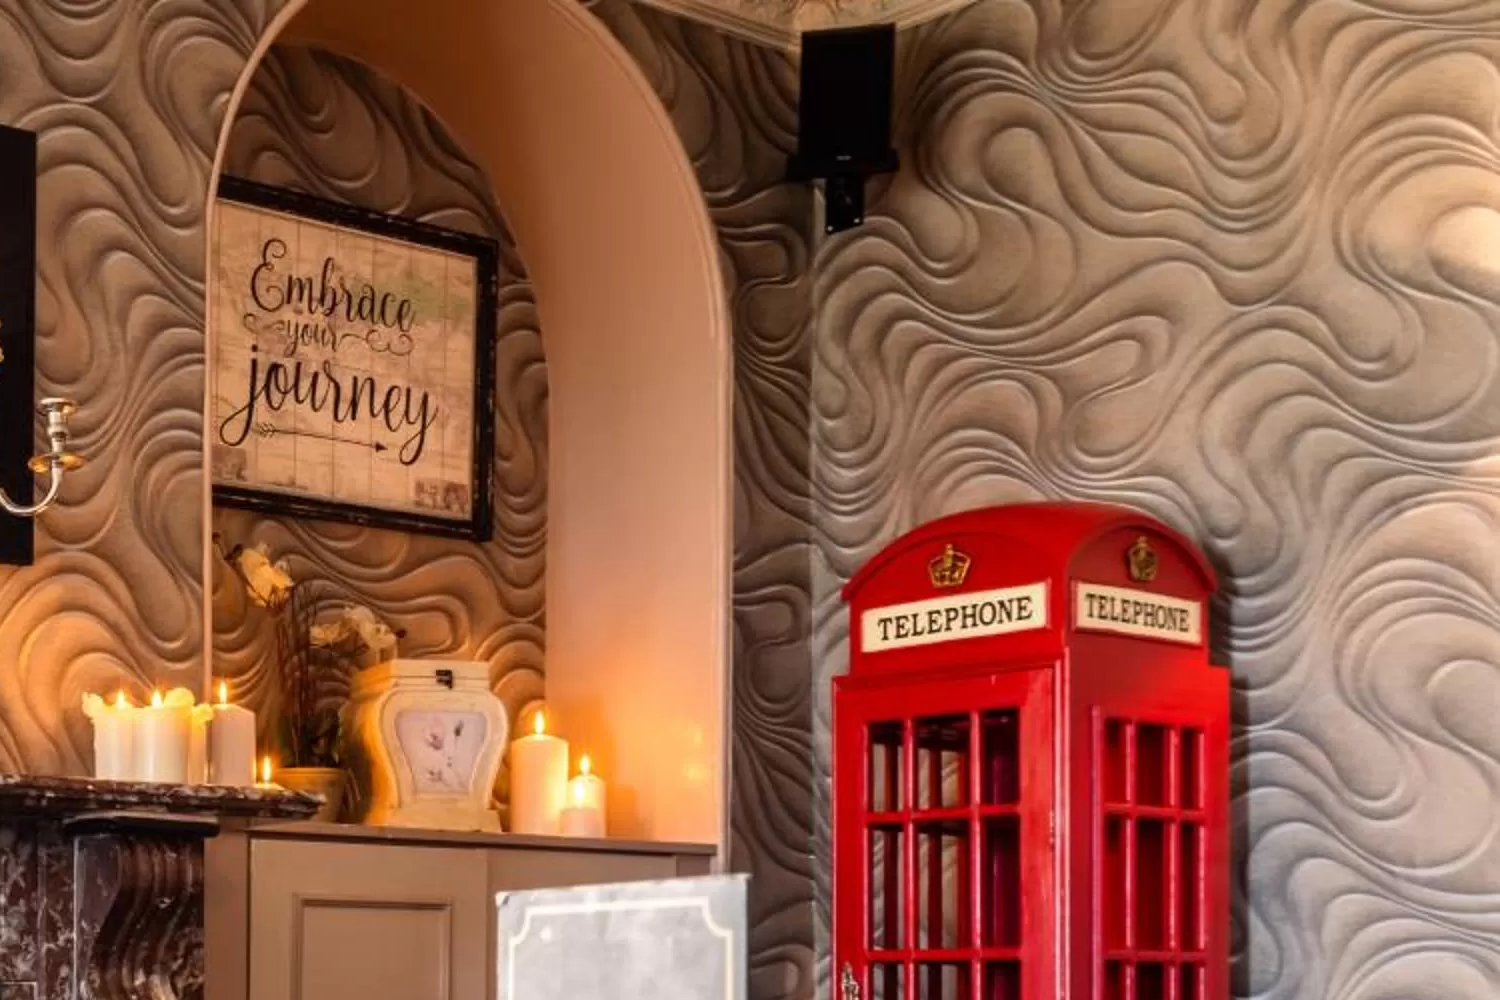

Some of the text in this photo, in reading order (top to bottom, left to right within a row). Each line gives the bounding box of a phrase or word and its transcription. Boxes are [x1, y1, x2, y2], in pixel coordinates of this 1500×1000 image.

[251, 238, 415, 333] Embrace
[219, 343, 440, 466] journey
[877, 595, 1034, 643] TELEPHONE
[1084, 593, 1191, 634] TELEPHONE
